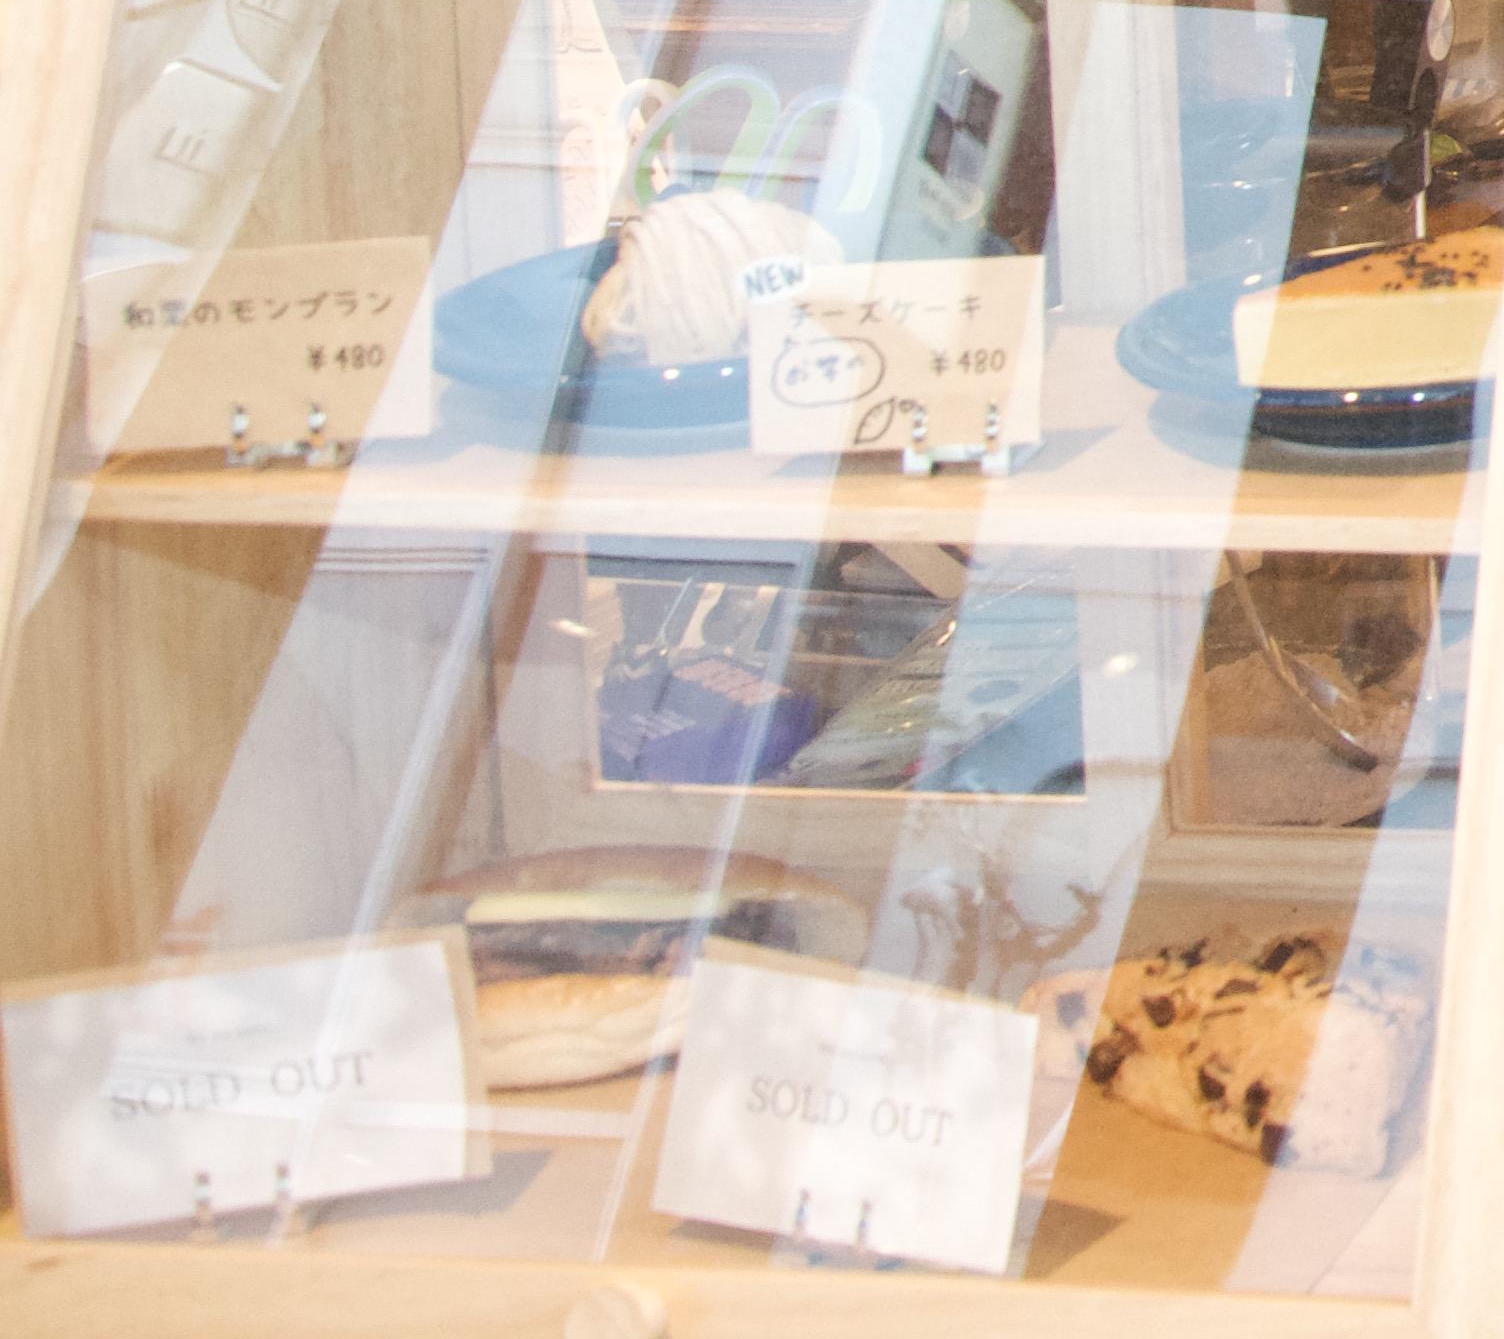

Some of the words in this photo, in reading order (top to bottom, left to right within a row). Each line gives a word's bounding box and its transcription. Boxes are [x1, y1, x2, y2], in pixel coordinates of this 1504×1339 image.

[744, 262, 806, 299] NEW
[124, 289, 394, 330] 和栗のモンブラン
[791, 294, 982, 326] チーズケーキ
[307, 343, 386, 372] ¥480
[929, 348, 1008, 376] ¥480
[110, 1071, 242, 1121] SOLD
[270, 1050, 374, 1099] OUT
[746, 1075, 851, 1126] SOLD
[869, 1096, 956, 1148] OUT
